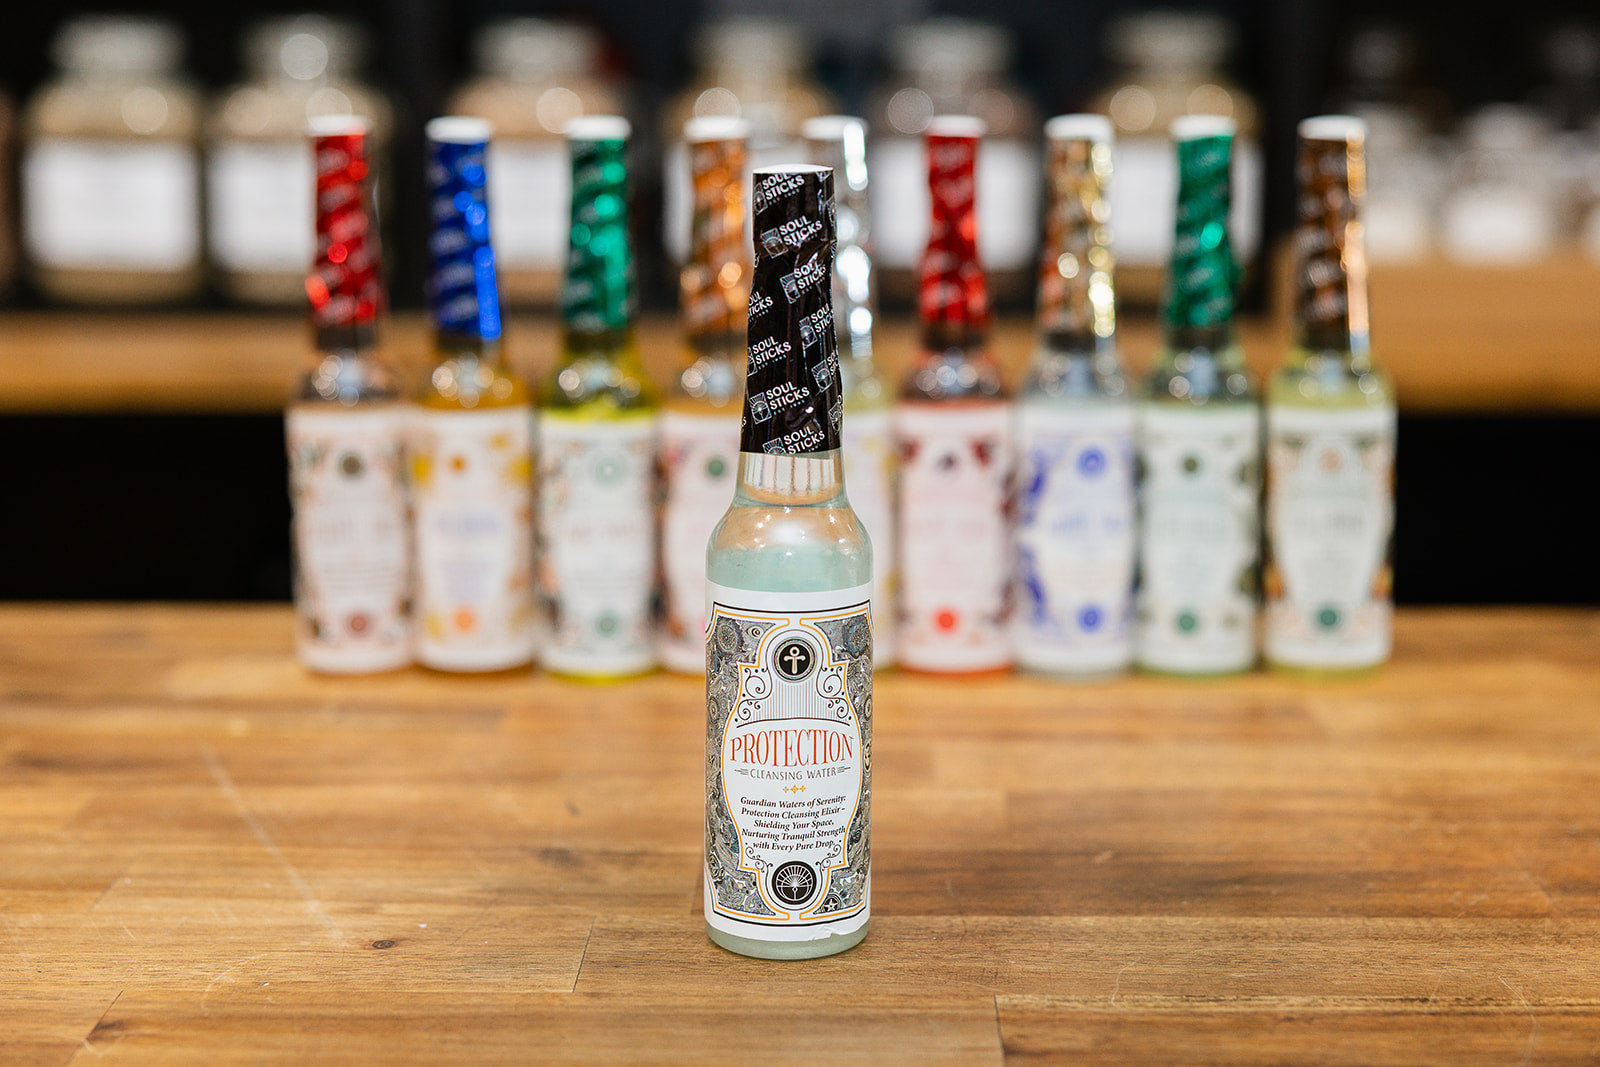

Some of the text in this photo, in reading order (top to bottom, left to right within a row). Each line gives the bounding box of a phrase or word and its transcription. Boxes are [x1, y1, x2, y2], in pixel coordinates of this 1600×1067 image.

[762, 172, 791, 190] SOUL
[765, 175, 805, 200] STICKS
[779, 216, 811, 235] SOUL
[784, 220, 822, 245] STICKS
[748, 296, 773, 317] TICKS
[752, 336, 779, 354] SOUL
[755, 341, 792, 365] STICKS
[766, 381, 797, 399] SOUL
[770, 387, 810, 410] STICKS
[783, 426, 814, 445] SOUL
[787, 430, 825, 454] STICKS
[730, 729, 854, 767] PROTECTION
[750, 767, 837, 780] CLEANSING WATER
[740, 796, 777, 808] Guardian
[779, 800, 806, 808] Waters
[806, 798, 817, 809] of
[741, 807, 780, 819] Protection
[781, 810, 820, 820] Cleansing
[821, 806, 841, 816] Elixir
[742, 825, 846, 841] Nurturing Tranquil Strength
[753, 820, 790, 831] Shielding
[792, 822, 809, 830] Your
[753, 842, 770, 850] with
[771, 843, 794, 853] Every
[795, 843, 814, 851] Pure
